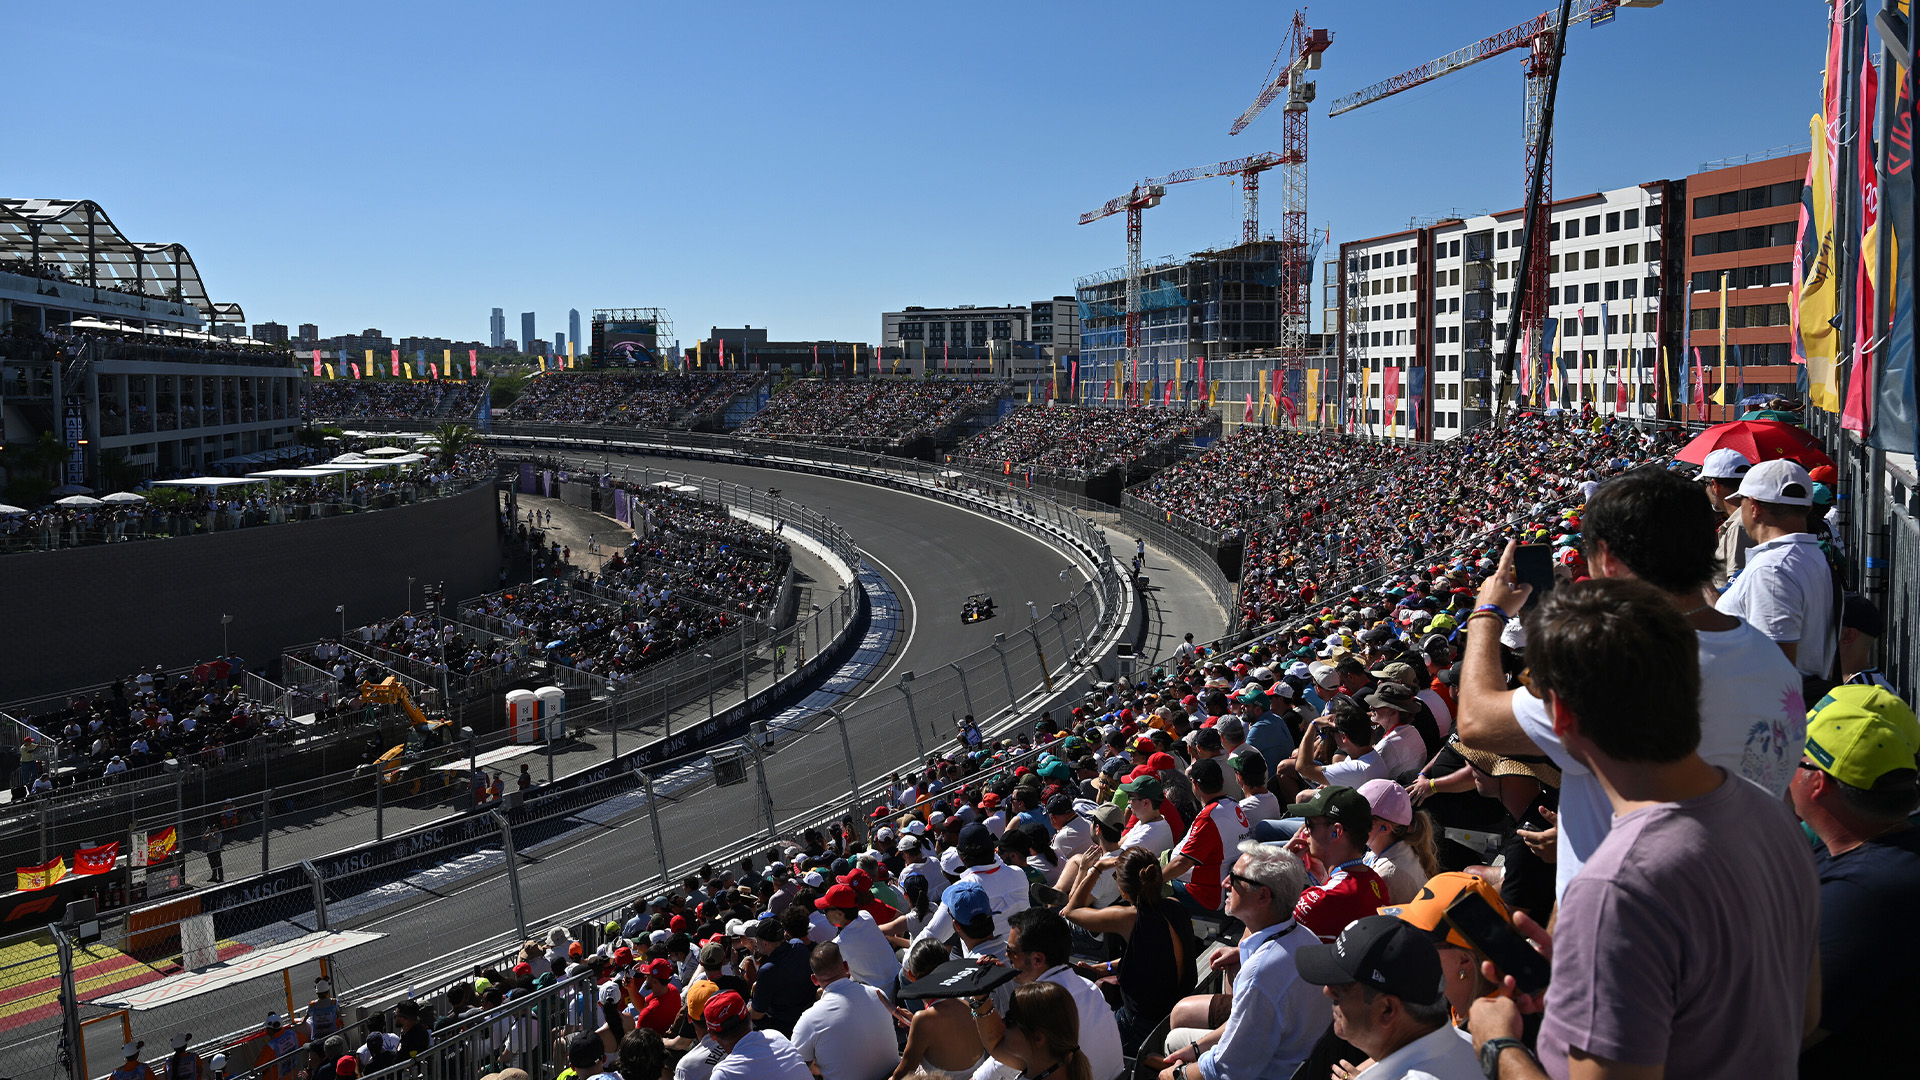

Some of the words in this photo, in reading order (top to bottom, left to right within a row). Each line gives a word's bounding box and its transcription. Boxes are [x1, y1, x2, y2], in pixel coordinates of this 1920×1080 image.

[732, 707, 745, 722] MSC
[702, 720, 719, 737] MSC
[670, 735, 687, 750] MSC
[631, 752, 651, 769] MSC
[588, 768, 610, 784] MSC
[411, 828, 445, 851] MSC
[333, 851, 373, 877] MSC
[243, 878, 287, 902] MSC
